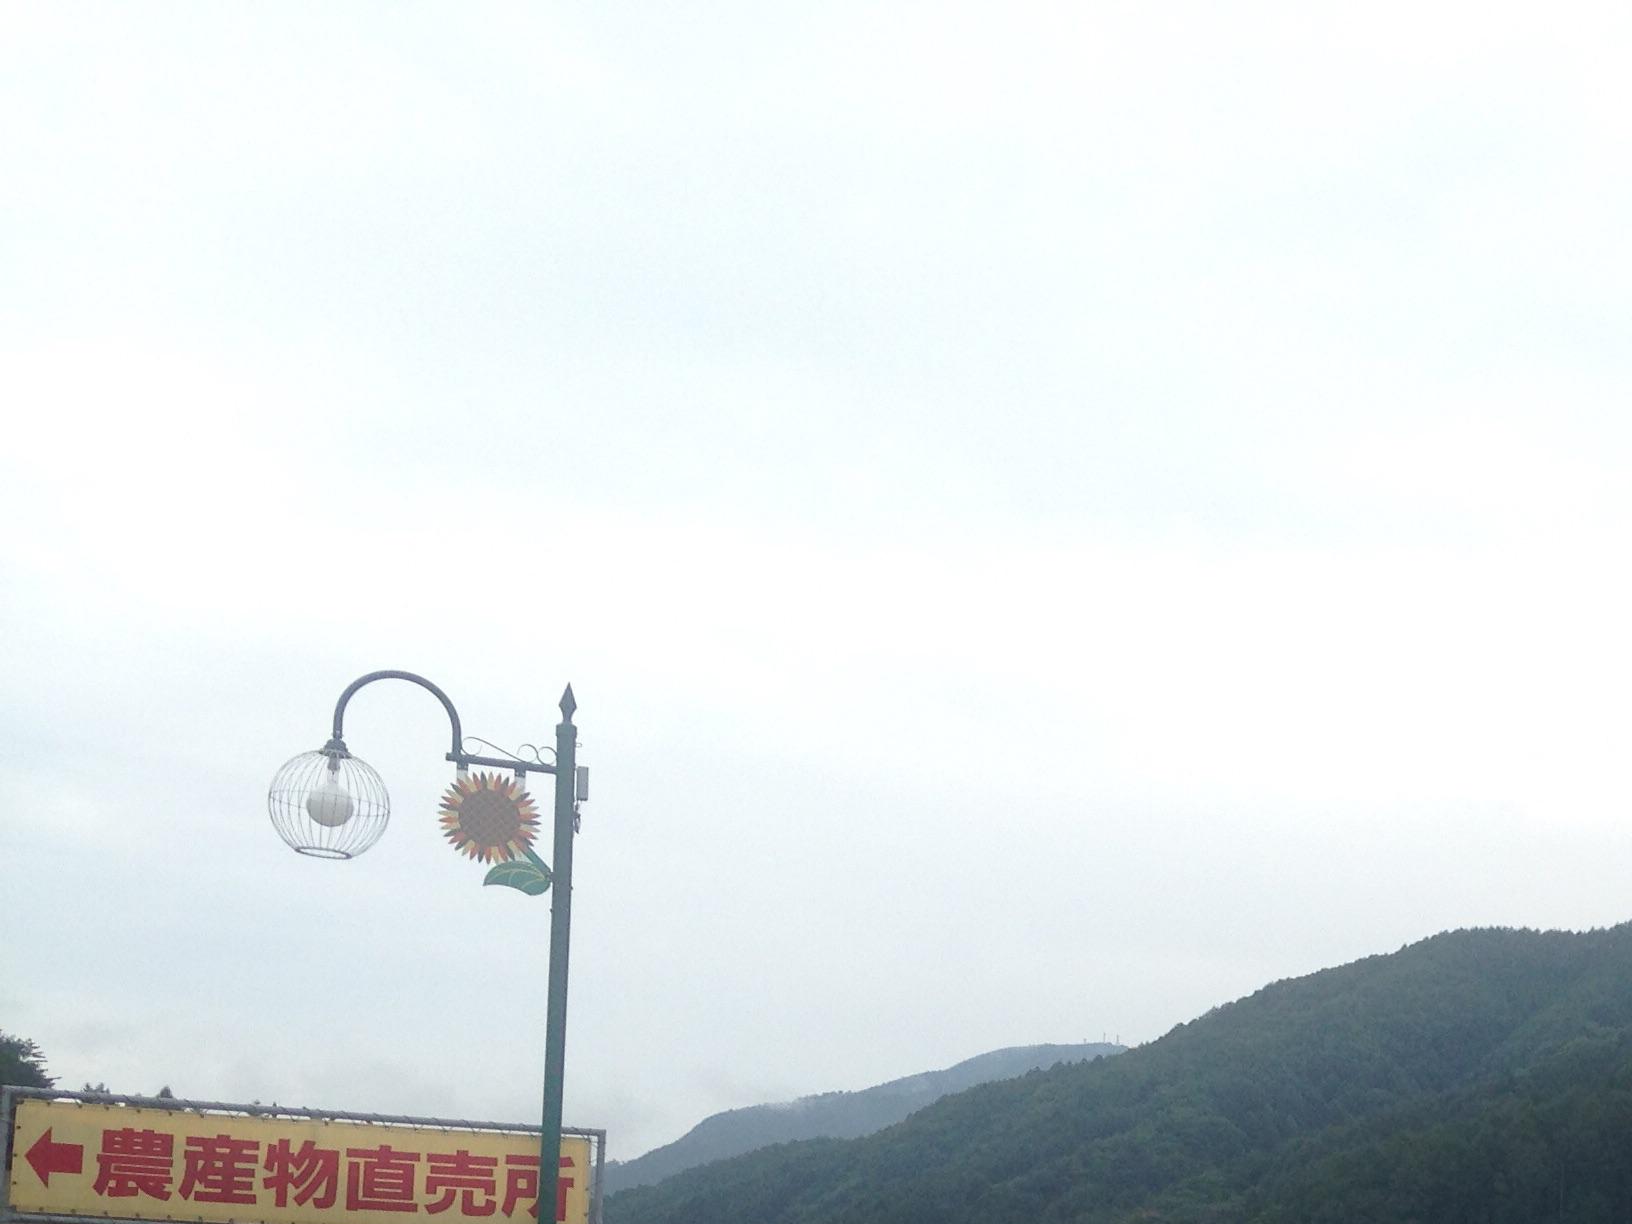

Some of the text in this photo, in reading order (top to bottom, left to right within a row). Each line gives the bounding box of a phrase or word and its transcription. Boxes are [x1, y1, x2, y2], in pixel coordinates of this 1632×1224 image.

[93, 1127, 575, 1222] 農産物直売所
